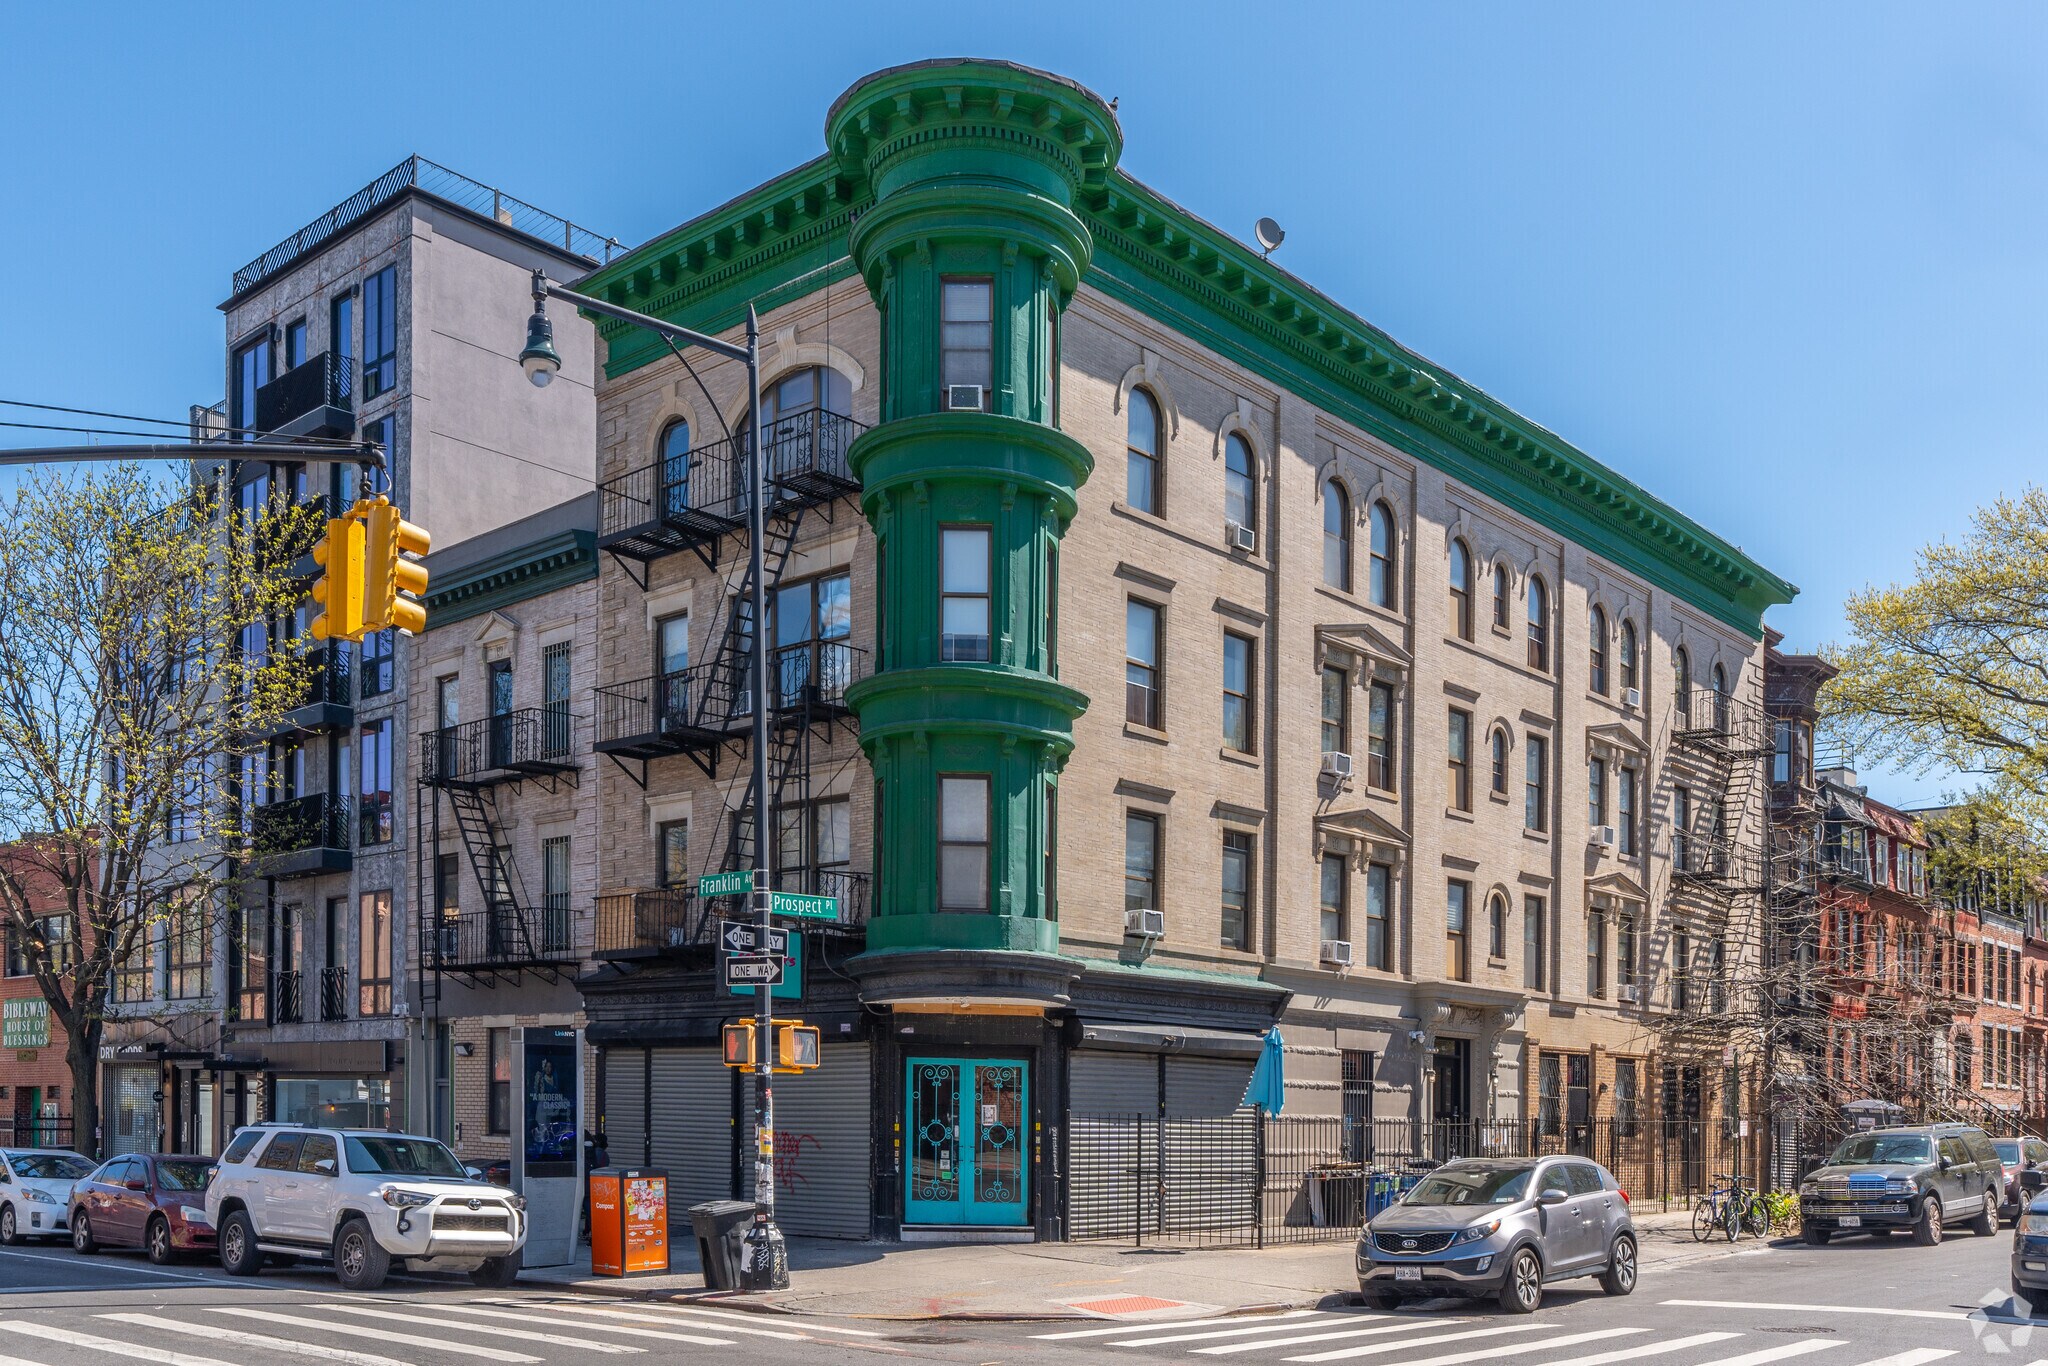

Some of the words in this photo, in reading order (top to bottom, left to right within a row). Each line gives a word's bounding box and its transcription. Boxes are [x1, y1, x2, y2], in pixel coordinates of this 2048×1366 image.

[700, 873, 741, 895] Franklin
[774, 895, 822, 915] Prospect
[825, 900, 833, 910] Pl
[732, 931, 751, 944] ONE
[769, 935, 780, 948] AY
[734, 965, 751, 977] ONE
[757, 965, 774, 976] WAY
[3, 1001, 48, 1019] BIBLEWAY
[6, 1020, 31, 1033] HOUSE
[34, 1019, 46, 1032] OF
[3, 1033, 48, 1046] BLESSINGS
[100, 1046, 115, 1059] DRY
[538, 1092, 563, 1102] MODERN
[595, 1201, 615, 1211] Compost
